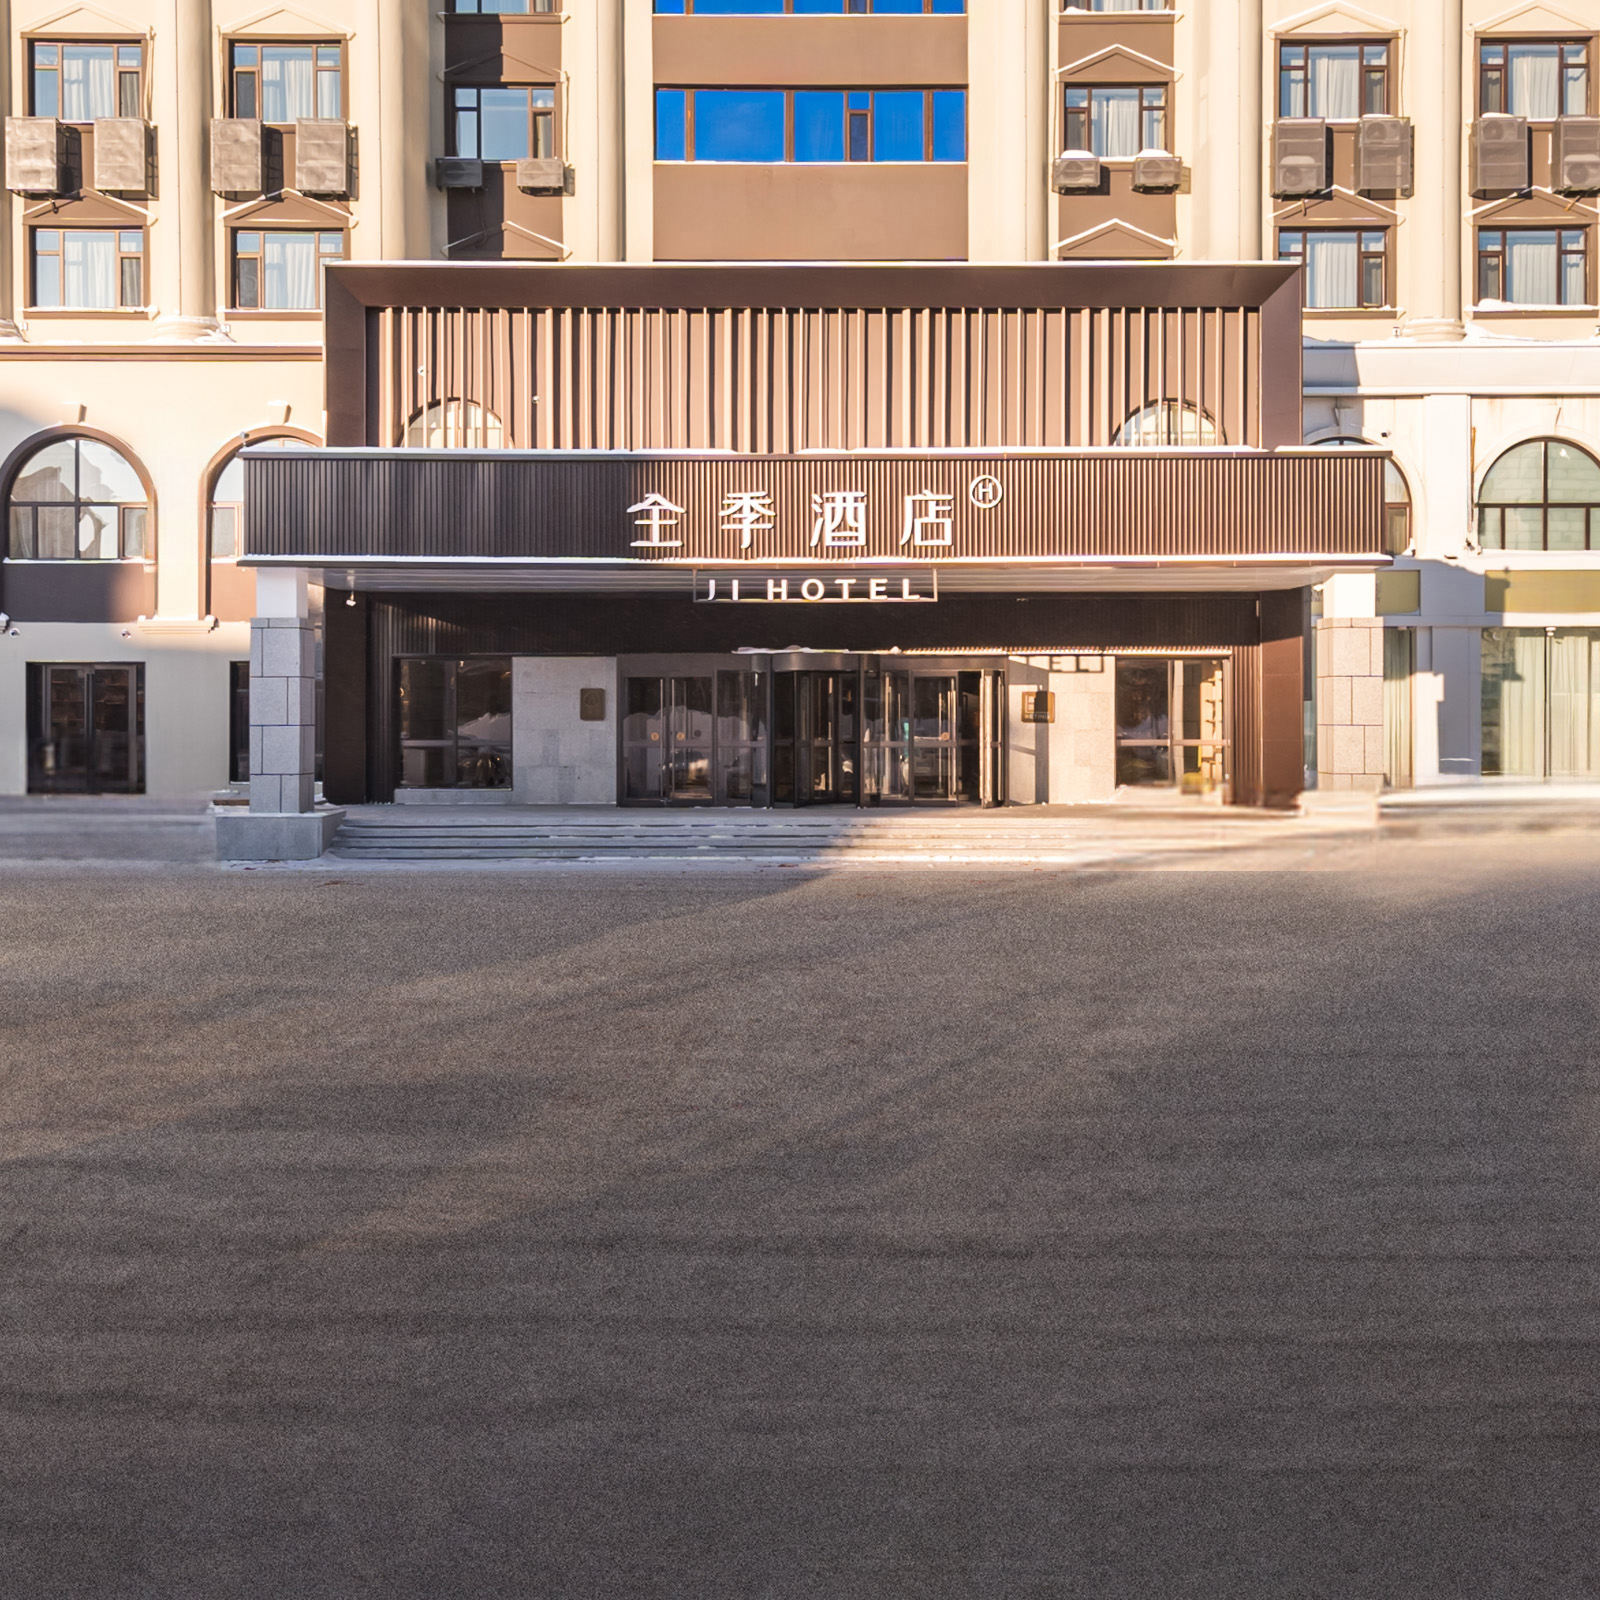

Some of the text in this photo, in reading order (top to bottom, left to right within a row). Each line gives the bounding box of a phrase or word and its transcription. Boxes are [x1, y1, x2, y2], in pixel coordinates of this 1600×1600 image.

[626, 489, 955, 549] 全季酒店
[706, 578, 921, 601] JI HOTEL
